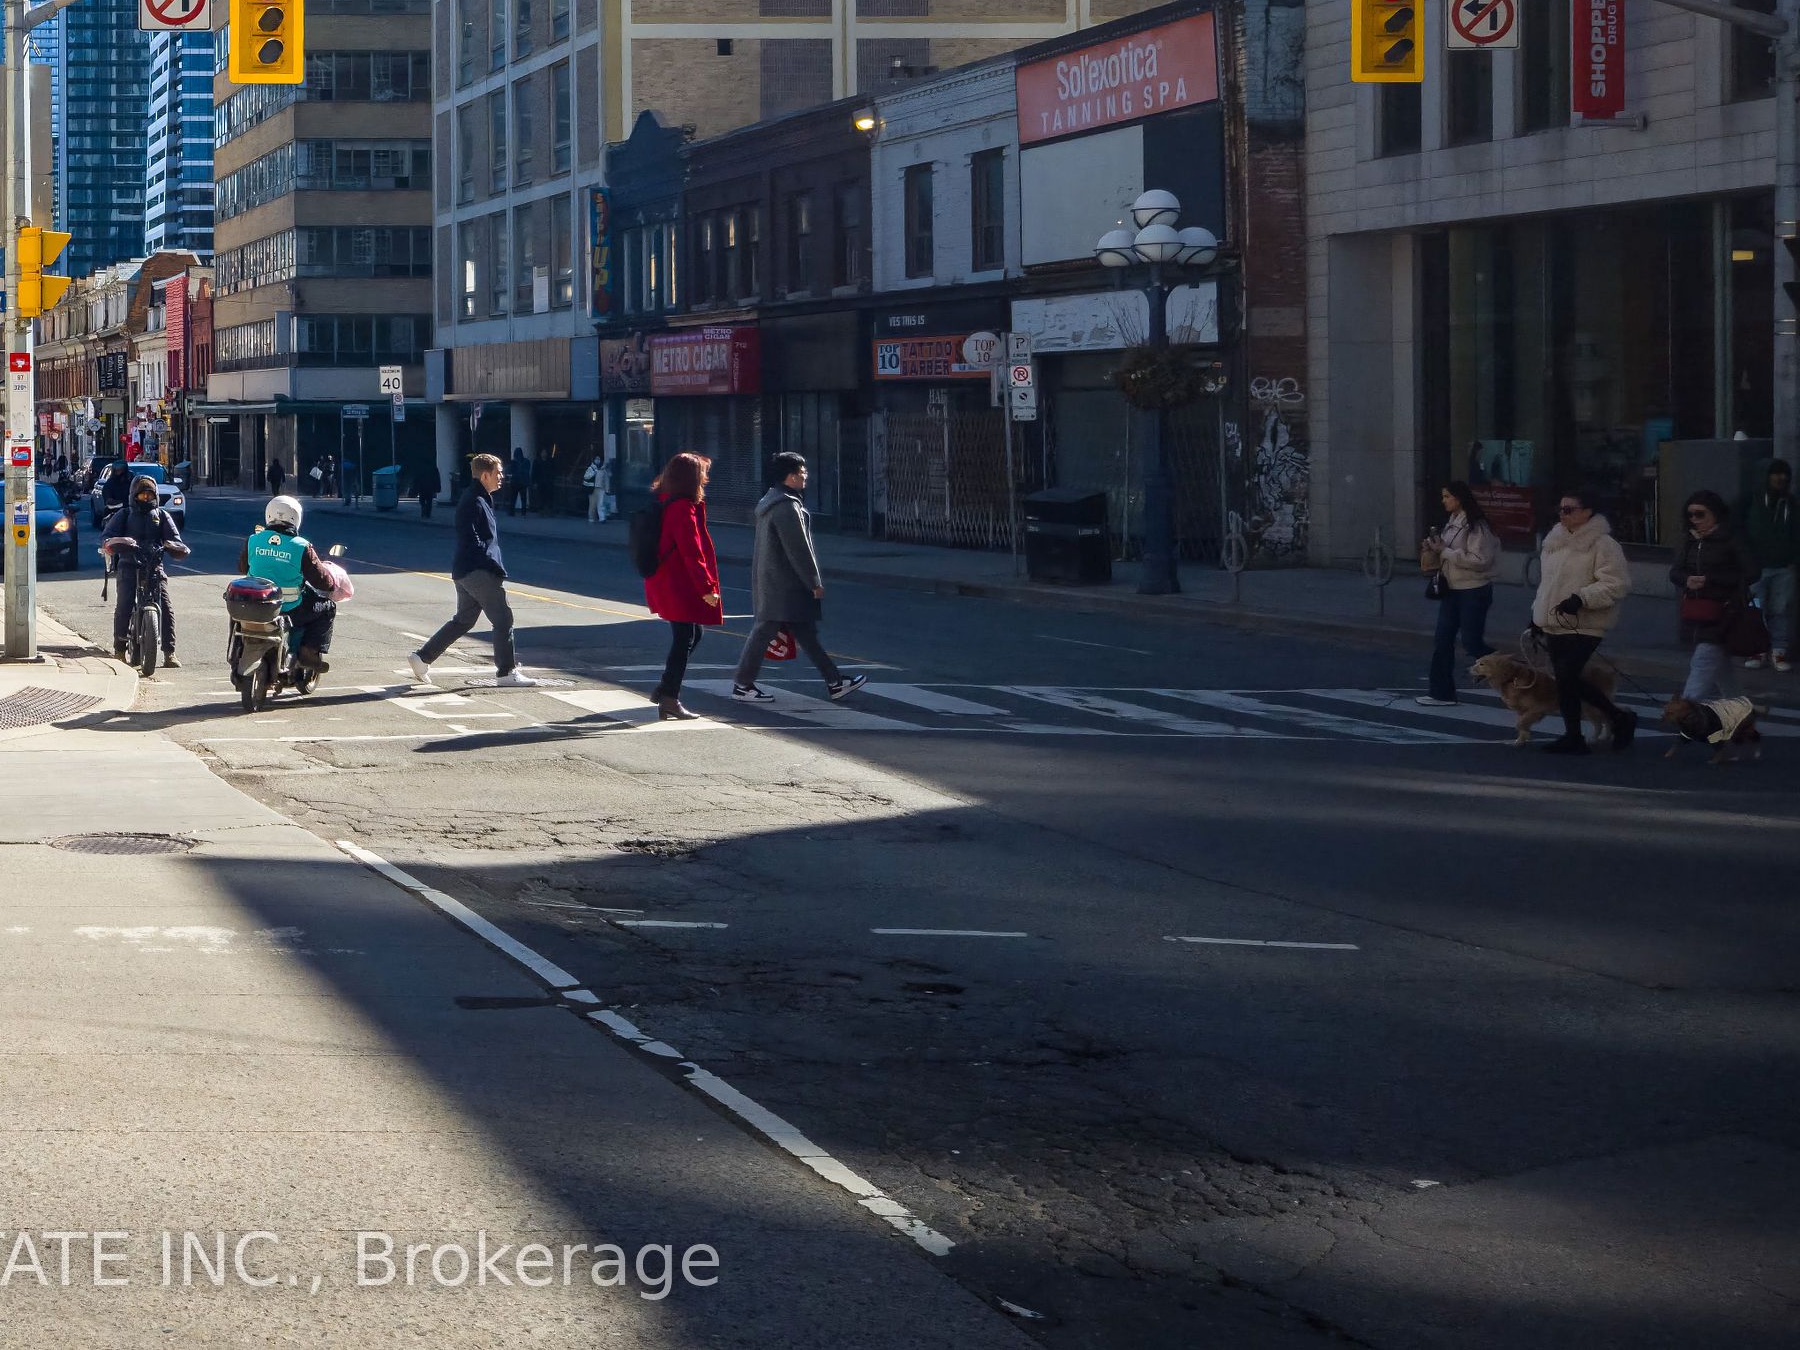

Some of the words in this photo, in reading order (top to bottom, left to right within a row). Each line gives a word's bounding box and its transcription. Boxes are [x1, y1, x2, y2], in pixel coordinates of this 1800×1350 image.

[1608, 5, 1617, 45] DRUG
[1041, 90, 1132, 133] TANNING
[1143, 76, 1187, 109] SPA
[879, 345, 899, 354] TOP
[901, 341, 952, 359] TATTOO
[975, 339, 995, 351] TOP
[653, 346, 689, 373] METRO
[692, 344, 728, 371] CIGAR
[878, 354, 899, 370] 10
[977, 352, 991, 362] 10
[902, 360, 950, 376] BARBER
[382, 377, 401, 390] 40
[255, 546, 292, 560] Fantuan
